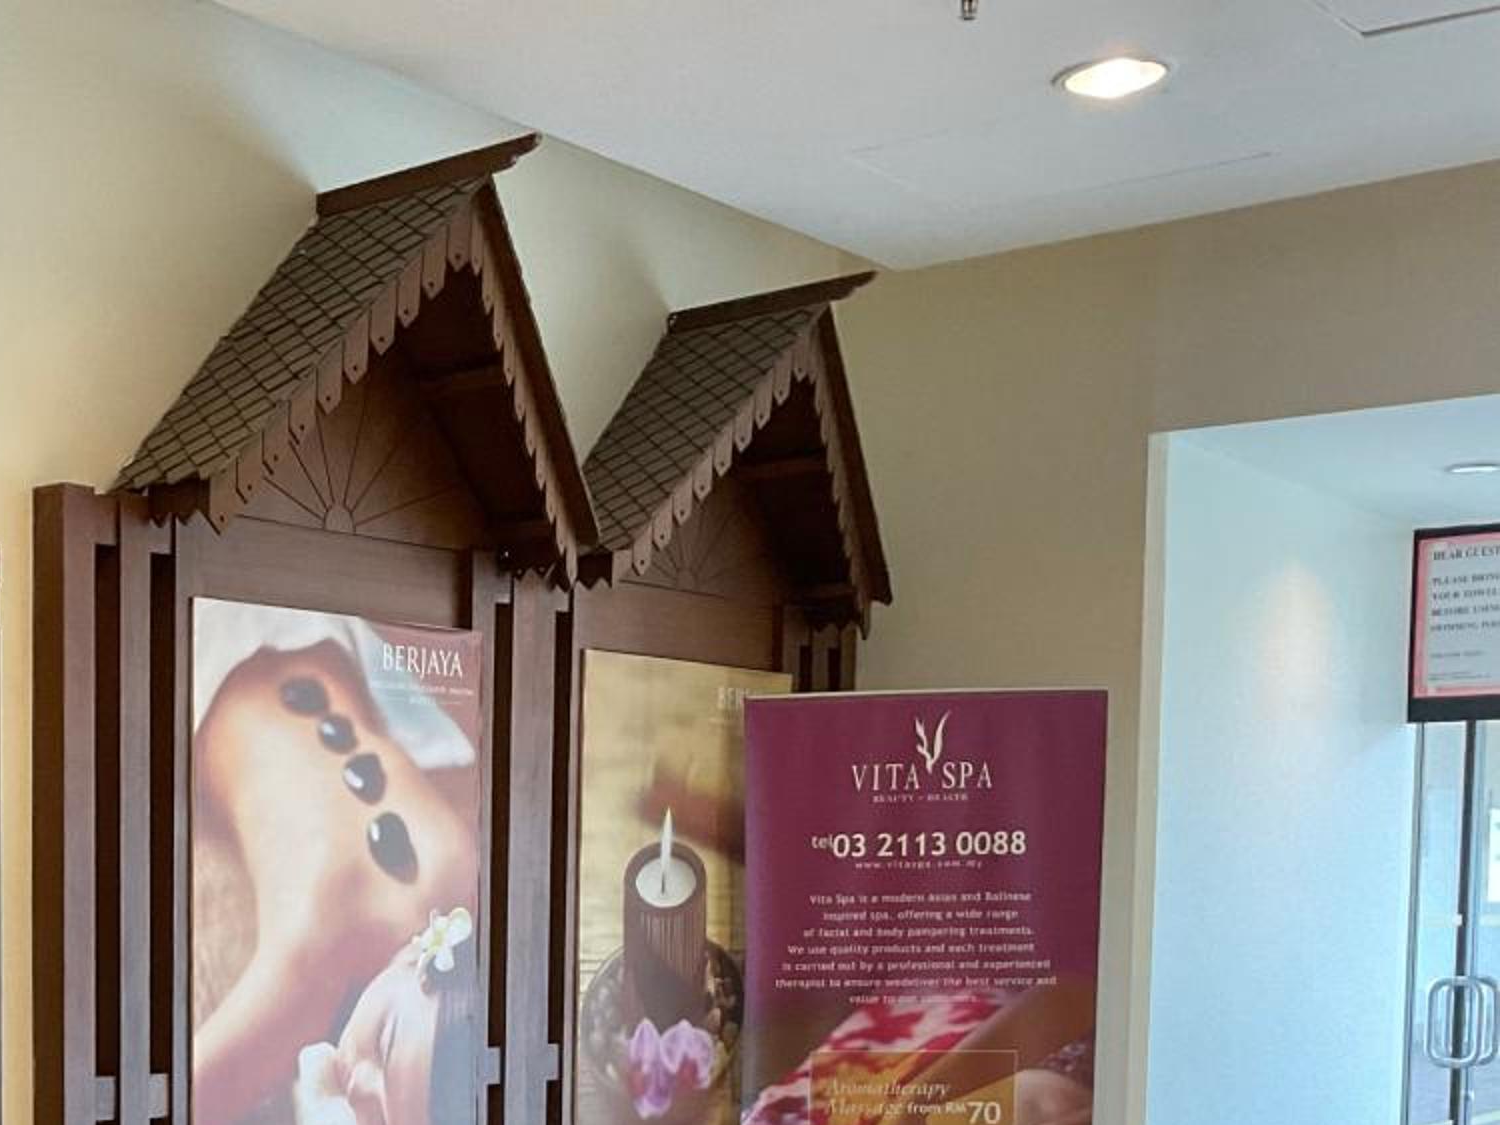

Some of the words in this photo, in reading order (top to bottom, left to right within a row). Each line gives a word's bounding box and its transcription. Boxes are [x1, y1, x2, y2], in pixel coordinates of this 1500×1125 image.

[383, 643, 463, 680] BERJAYA
[852, 763, 920, 791] VITA
[941, 761, 993, 789] SPA
[833, 833, 866, 858] 03
[876, 831, 947, 857] 2113
[955, 830, 1027, 857] 0088
[966, 1101, 1001, 1125] 70
